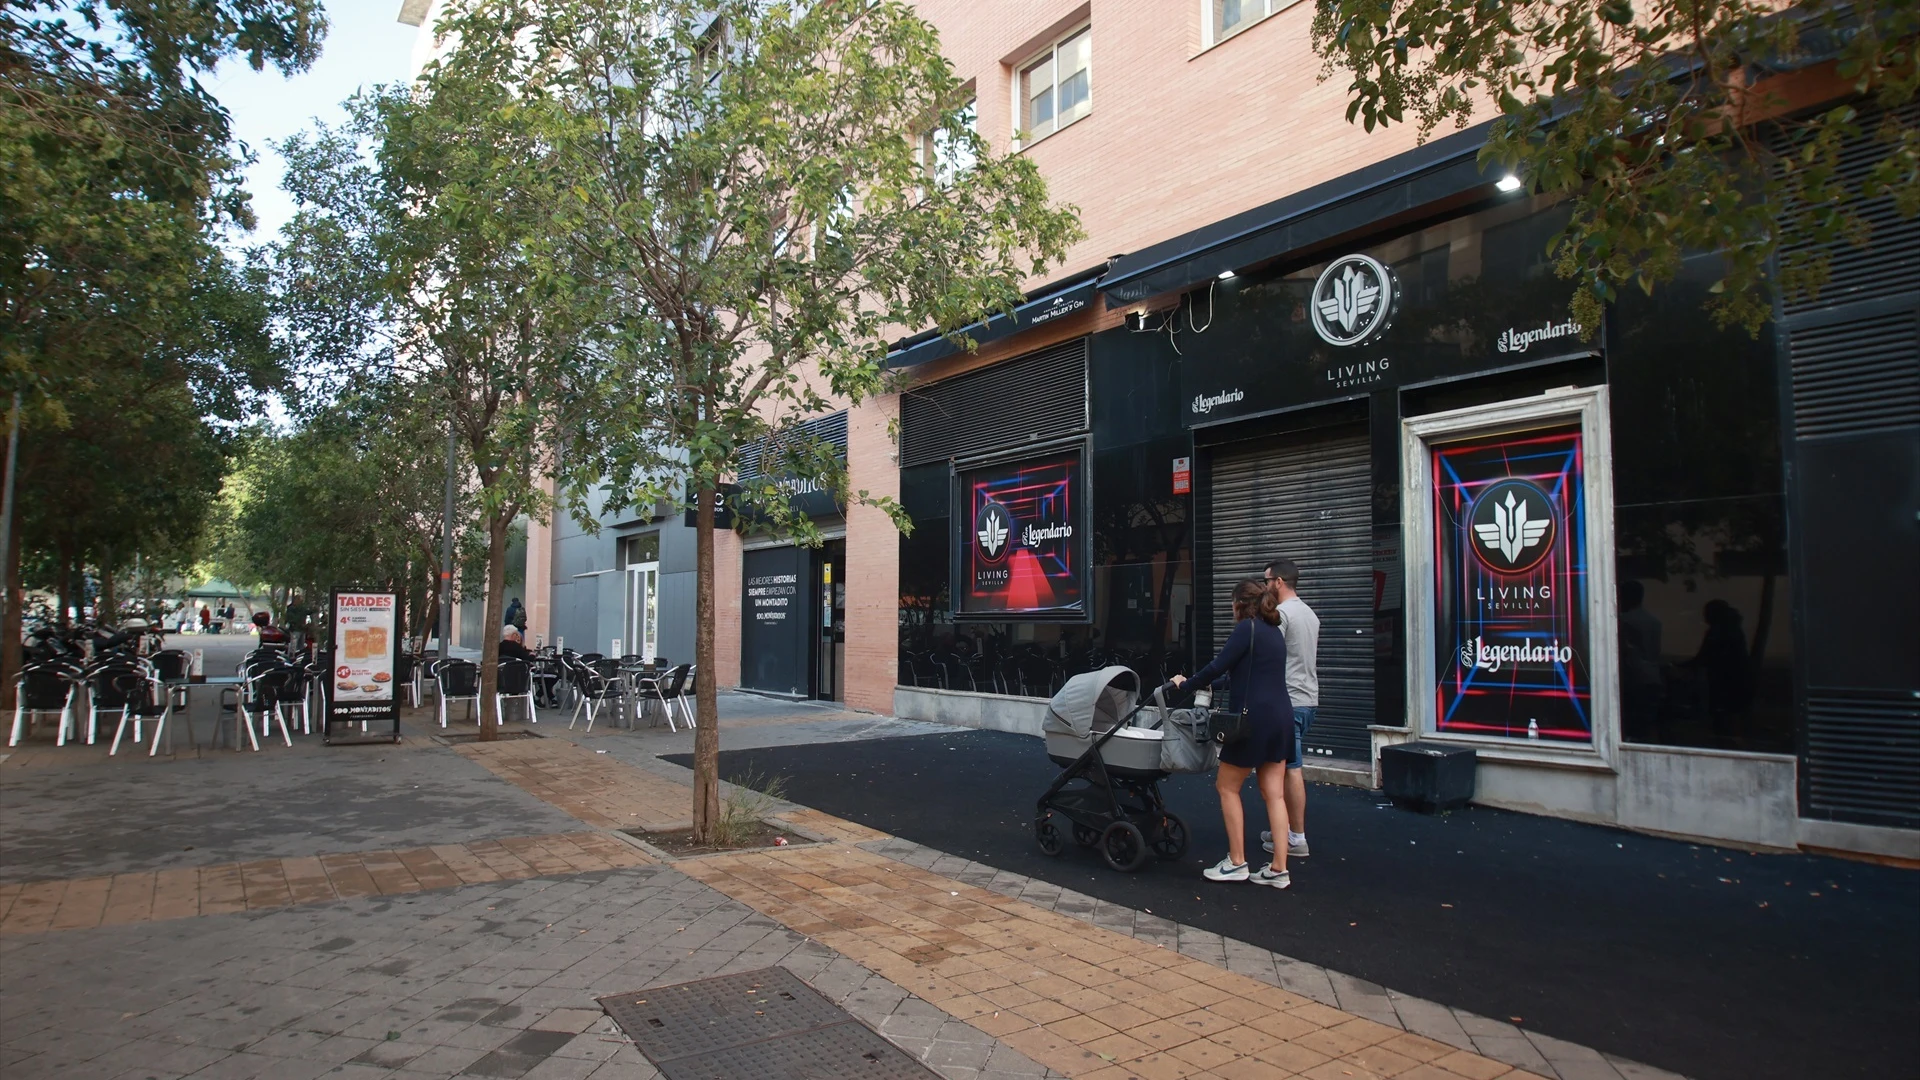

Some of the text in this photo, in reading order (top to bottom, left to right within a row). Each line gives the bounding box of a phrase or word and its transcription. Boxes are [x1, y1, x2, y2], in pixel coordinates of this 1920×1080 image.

[1031, 313, 1050, 324] MARTIN
[1050, 304, 1073, 318] MILLER'S
[1073, 300, 1085, 309] GIN
[1327, 357, 1390, 381] LIVING
[1336, 374, 1382, 388] SEVILLA
[1199, 387, 1244, 414] Legendario
[1028, 521, 1072, 548] Legendario
[773, 574, 796, 583] HISTORIAS
[977, 570, 1008, 580] LIVING
[748, 587, 766, 596] SIEMPRE
[1477, 586, 1551, 600] LIVING
[338, 596, 392, 607] TARDES
[755, 598, 788, 607] UN MONTADITO
[1461, 635, 1572, 673] Ron Legendario
[349, 705, 392, 713] MONTADITOS
